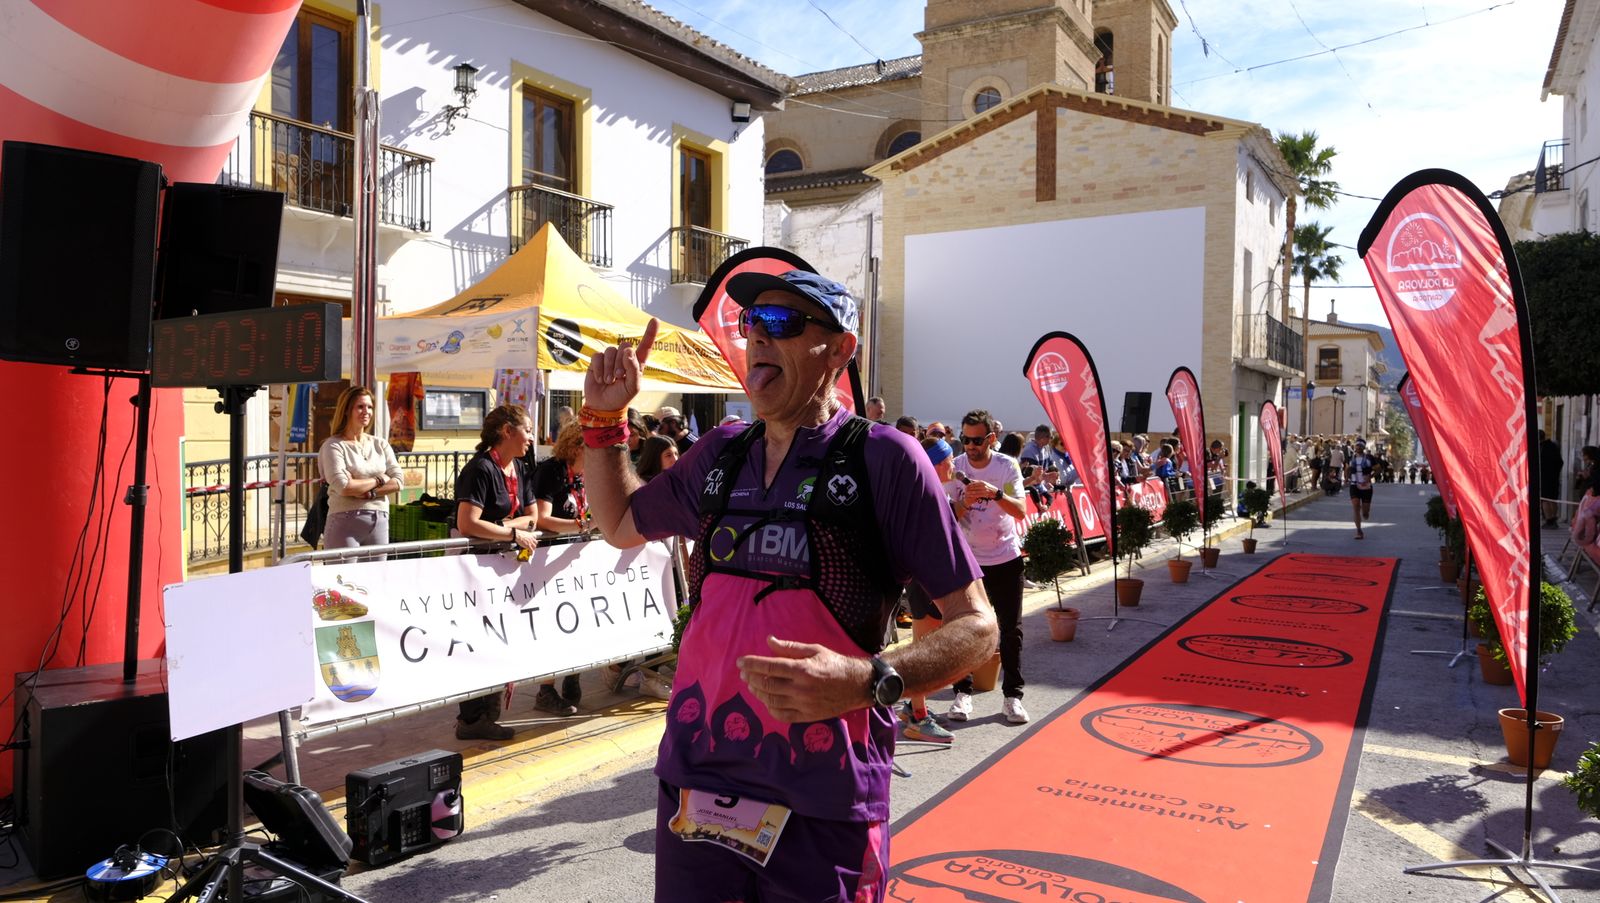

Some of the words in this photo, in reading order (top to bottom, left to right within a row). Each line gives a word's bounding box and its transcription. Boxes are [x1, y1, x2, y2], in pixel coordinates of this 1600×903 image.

[156, 312, 322, 380] 03:03:10
[784, 501, 796, 509] LOS
[400, 570, 617, 615] AYUNTAMIENTO
[626, 565, 650, 583] DE
[400, 587, 661, 663] CANTORIA
[1162, 675, 1311, 698] Ayuntamiento
[1179, 671, 1267, 687] Cantoria
[1065, 778, 1188, 806] Cantoria
[696, 808, 714, 816] JOSE
[1036, 785, 1249, 830] Ayuntamiento
[1198, 801, 1236, 814] de
[944, 861, 1118, 903] OLVORA
[976, 857, 1068, 884] Cantoria
